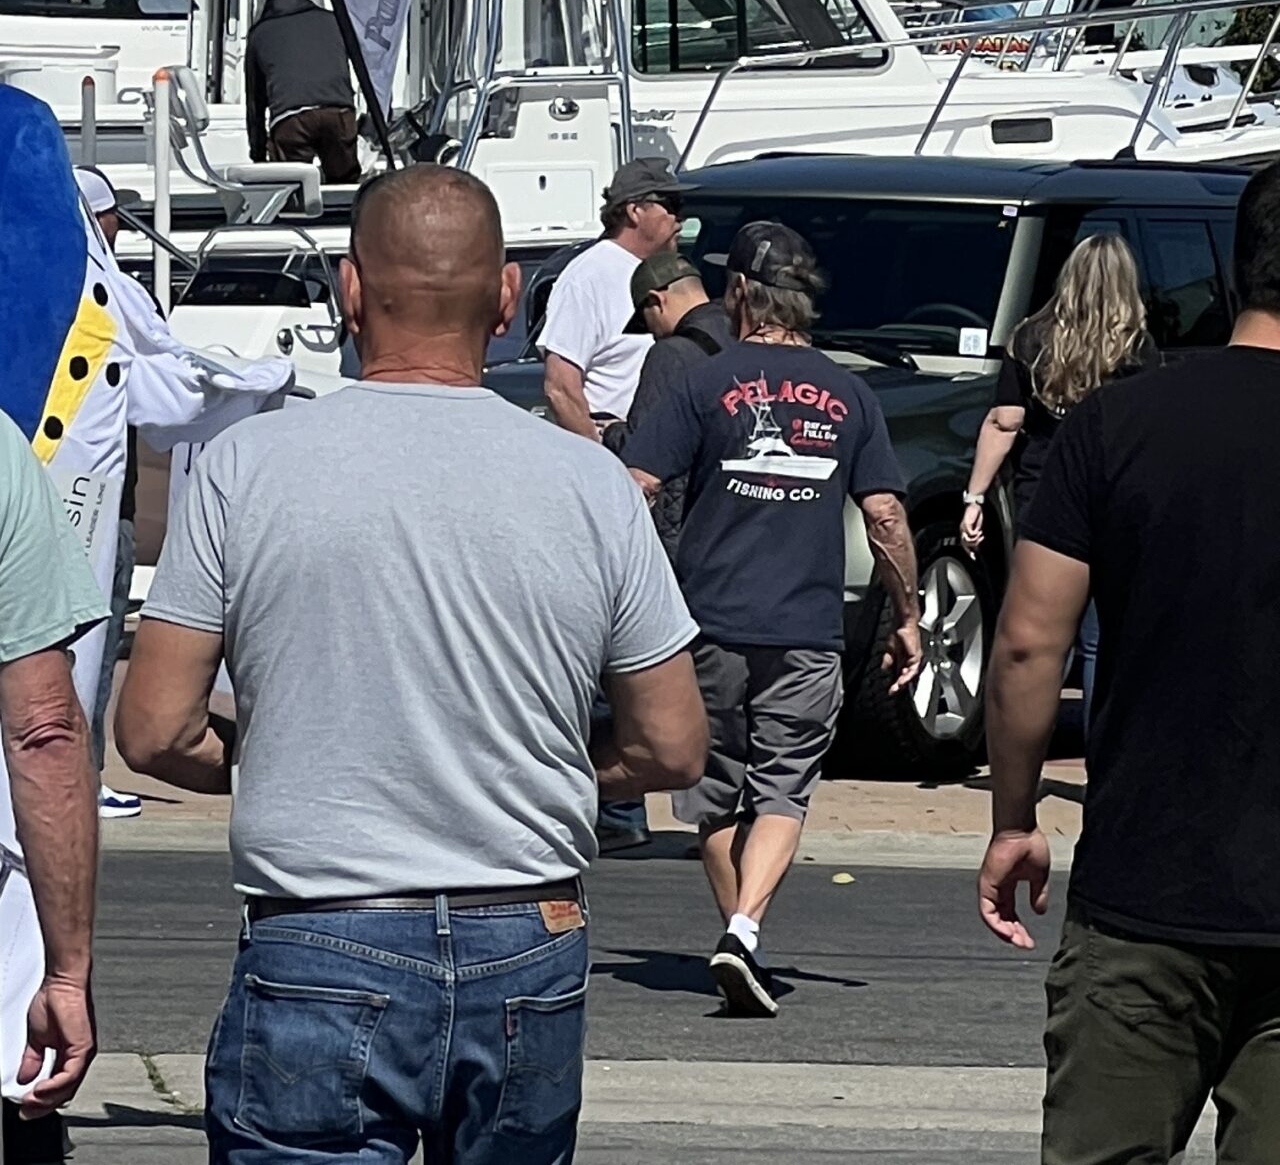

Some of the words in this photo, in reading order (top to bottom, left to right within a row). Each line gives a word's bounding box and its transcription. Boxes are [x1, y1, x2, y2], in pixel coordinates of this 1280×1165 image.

[722, 379, 849, 422] PELAGIC
[726, 478, 786, 501] FISHING
[789, 487, 821, 501] CO.
